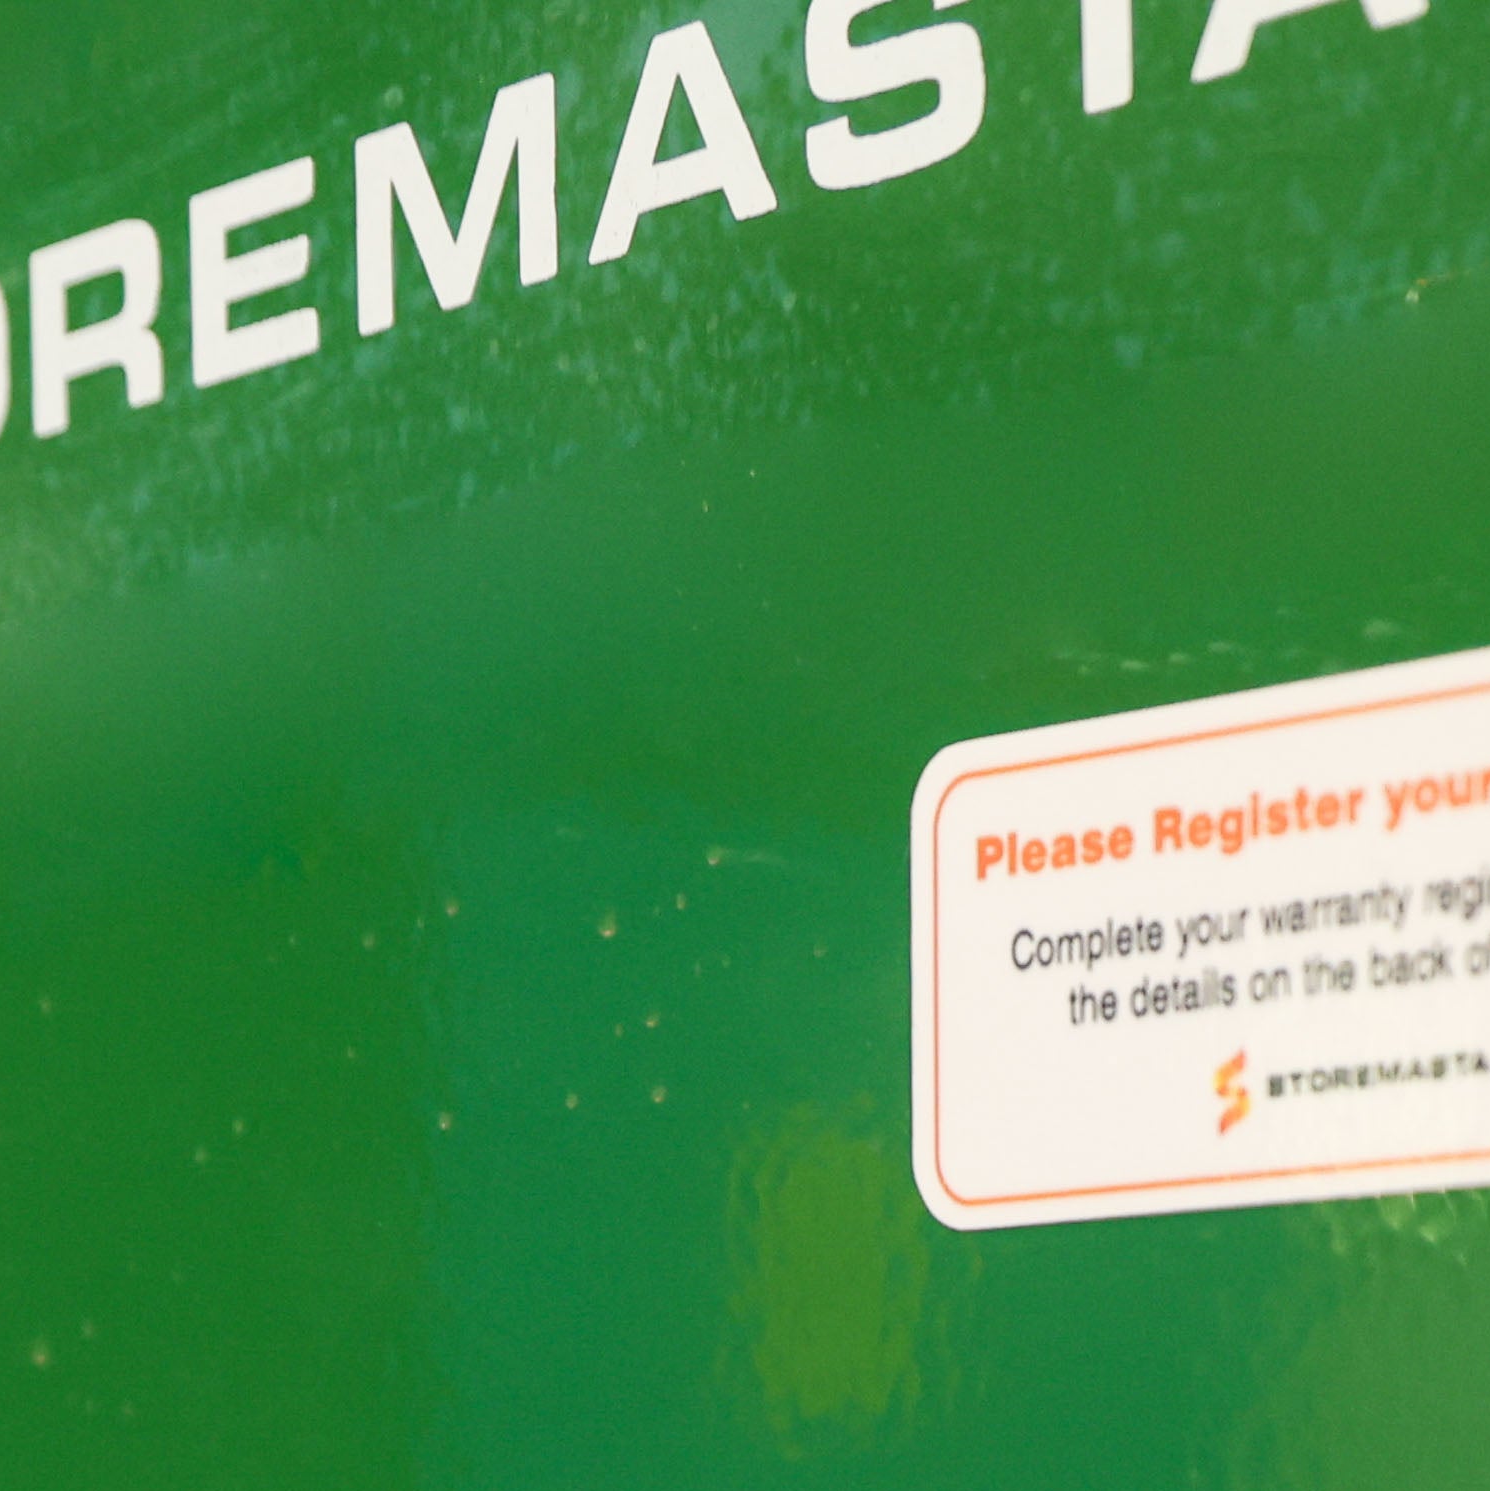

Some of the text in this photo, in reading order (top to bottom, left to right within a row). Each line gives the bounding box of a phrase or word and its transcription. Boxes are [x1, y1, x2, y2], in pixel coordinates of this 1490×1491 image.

[976, 822, 1134, 881] Please
[1153, 787, 1364, 854] Register
[1011, 917, 1164, 971] Complete
[1176, 906, 1249, 959] your
[1260, 880, 1410, 935] warranty
[1069, 984, 1119, 1025] the
[1130, 966, 1236, 1019] details
[1248, 970, 1292, 1004] on
[1303, 950, 1357, 996] the
[1370, 939, 1453, 987] back
